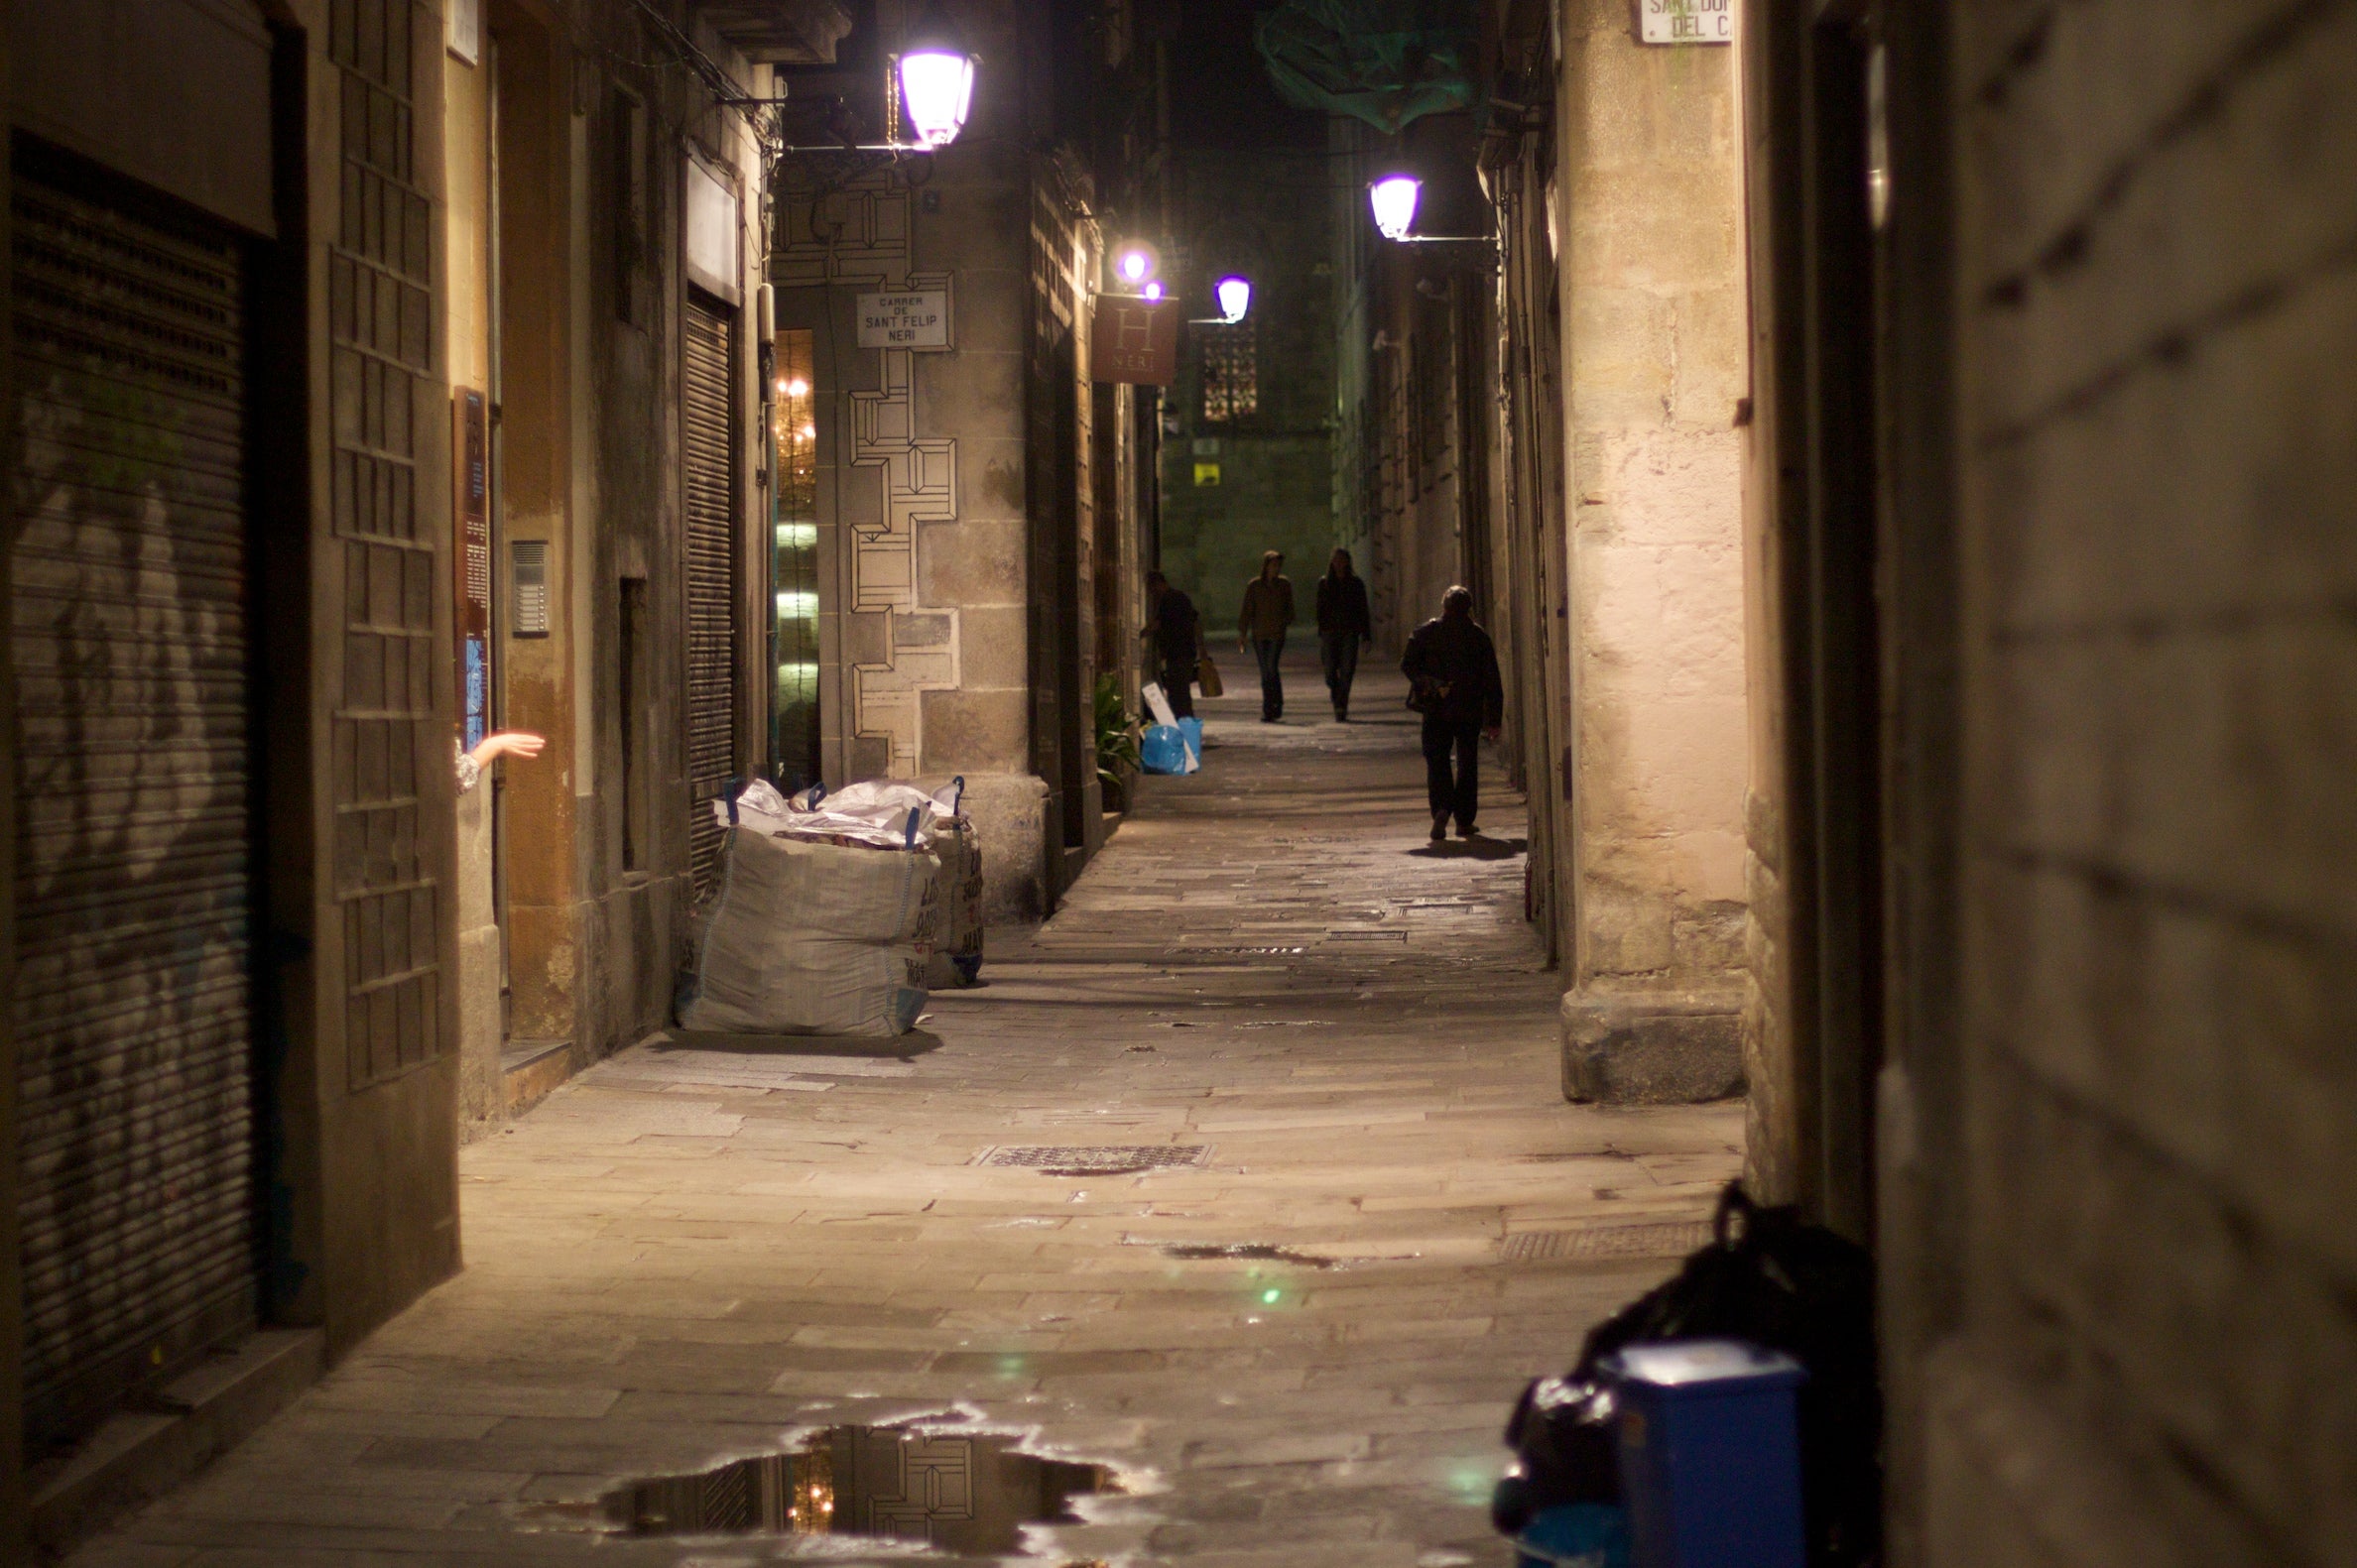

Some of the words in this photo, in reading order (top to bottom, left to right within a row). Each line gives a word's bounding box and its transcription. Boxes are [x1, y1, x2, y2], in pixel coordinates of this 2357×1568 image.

[1673, 16, 1706, 38] DEL
[1717, 15, 1732, 36] C
[879, 298, 923, 306] CARRER
[894, 306, 908, 315] DE
[866, 317, 897, 328] SANT
[903, 315, 936, 327] FELIP
[889, 330, 915, 341] NERI
[1112, 355, 1154, 372] NERI
